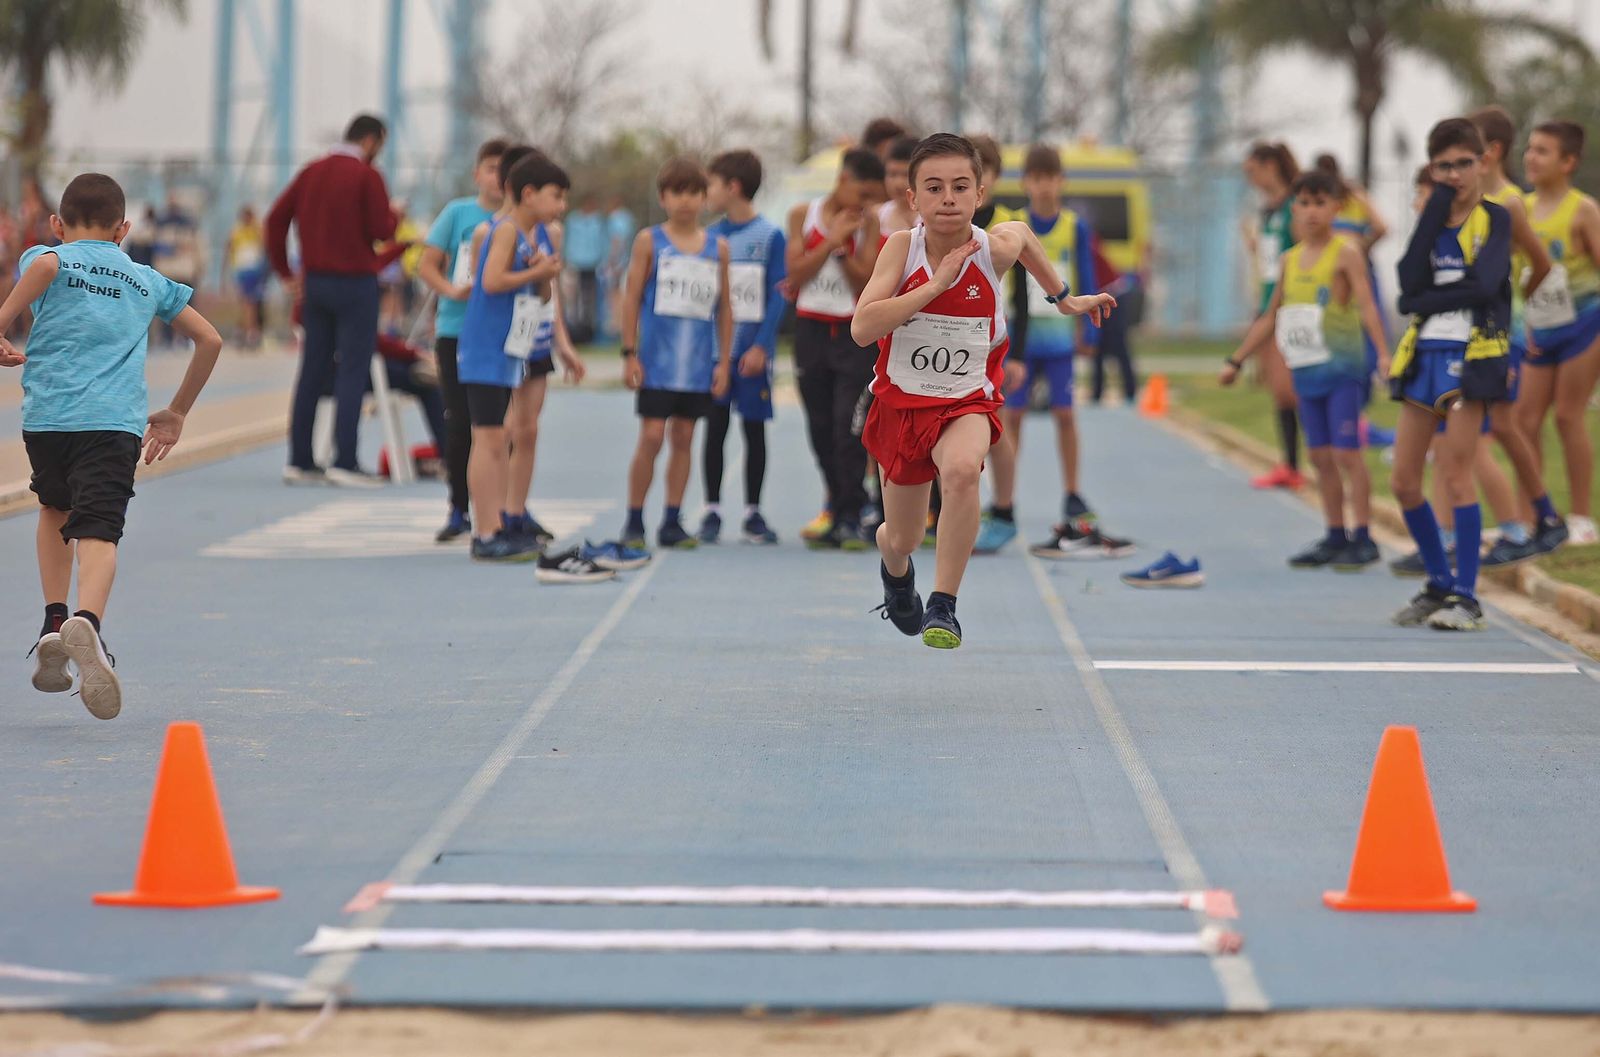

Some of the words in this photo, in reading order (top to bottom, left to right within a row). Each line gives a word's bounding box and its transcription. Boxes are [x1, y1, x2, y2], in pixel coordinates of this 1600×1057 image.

[67, 277, 121, 299] LINENSE
[72, 262, 87, 272] DE
[90, 266, 149, 297] ATLETISMO
[910, 345, 970, 376] 602
